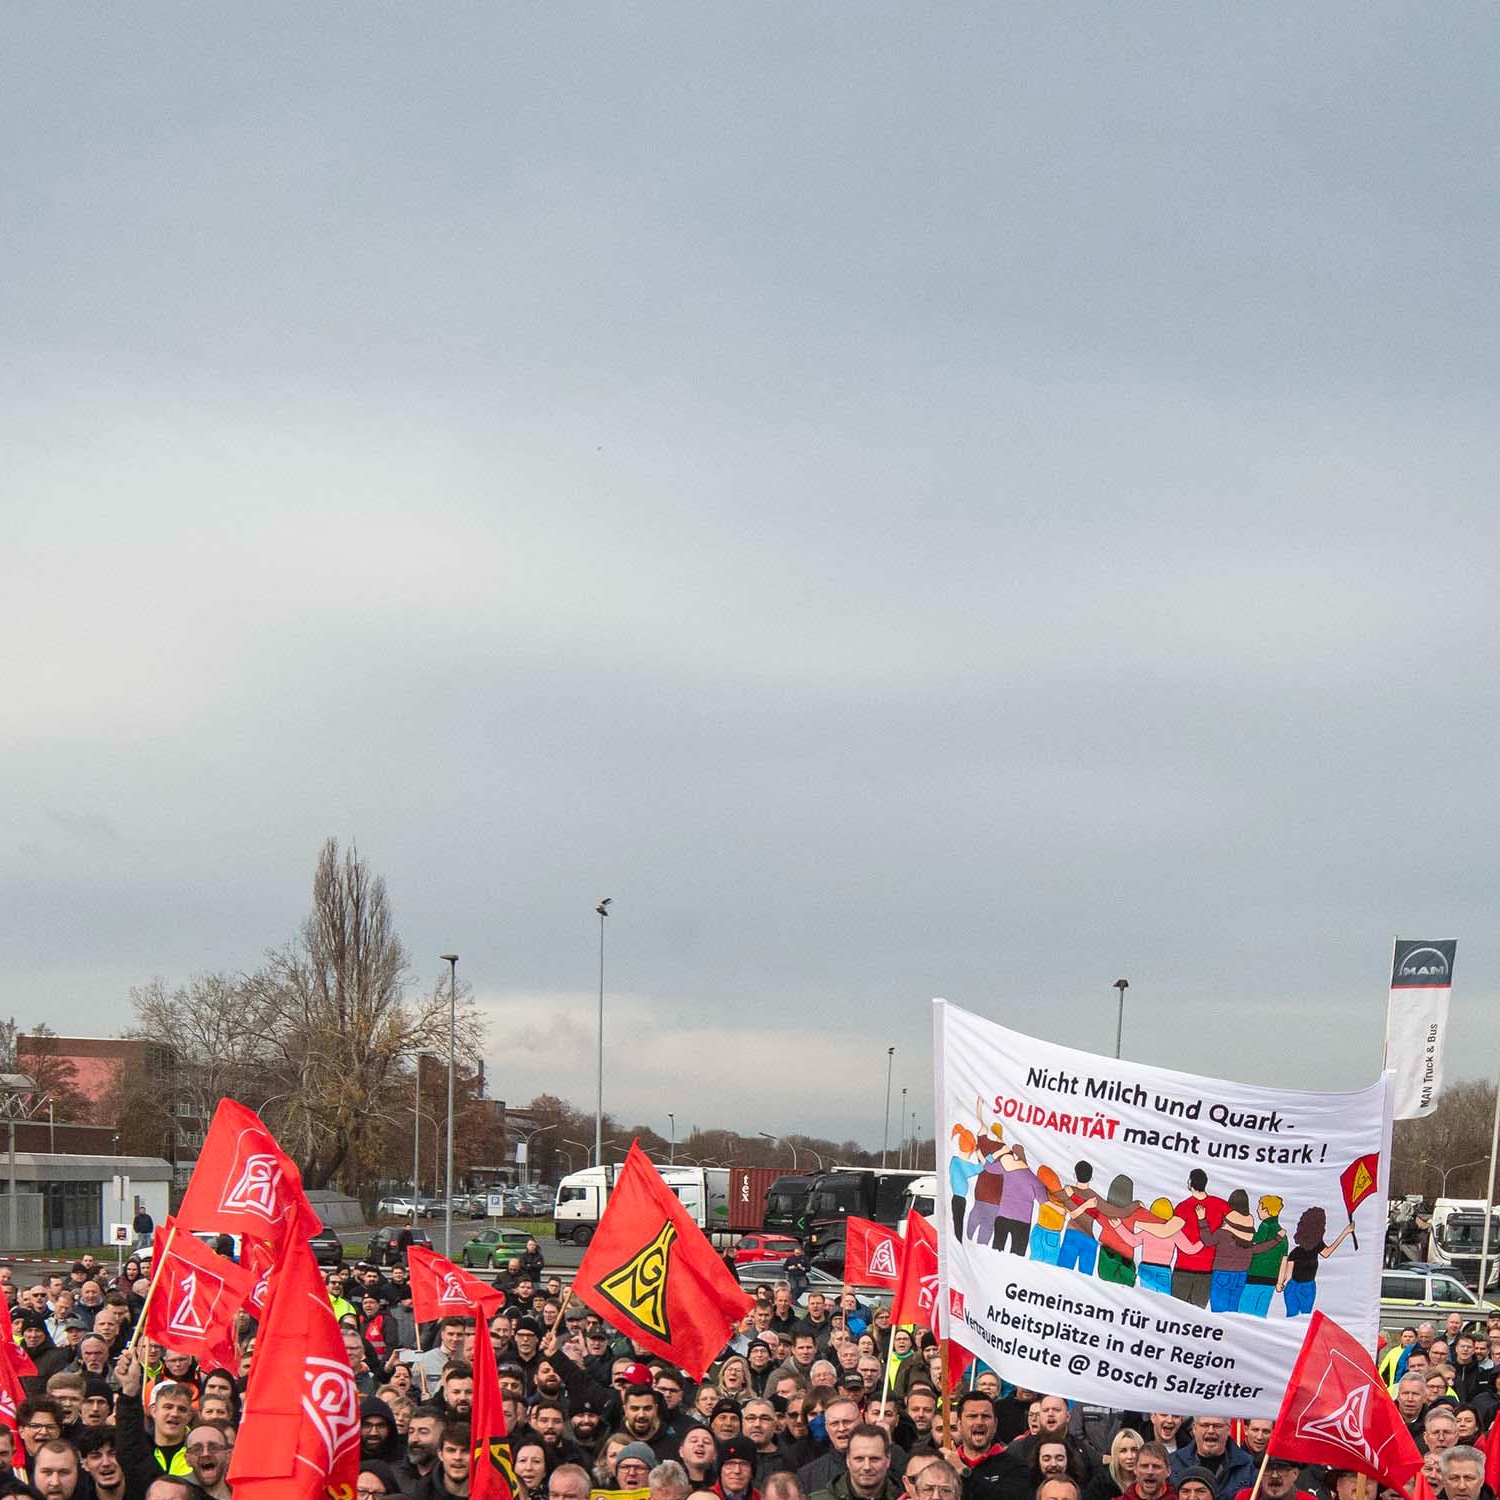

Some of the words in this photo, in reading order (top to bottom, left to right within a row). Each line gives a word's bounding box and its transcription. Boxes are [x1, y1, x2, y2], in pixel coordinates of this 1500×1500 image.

[1428, 1024, 1438, 1043] Bus
[1026, 1066, 1078, 1095] Nicht
[1084, 1077, 1148, 1107] Milch
[1154, 1095, 1202, 1121] und
[1209, 1104, 1283, 1133] Quark
[1420, 1087, 1432, 1108] MAN
[1423, 1056, 1434, 1084] Truck
[993, 1095, 1120, 1140] SOLIDARITÄT
[1123, 1125, 1200, 1155] macht
[1207, 1141, 1249, 1161] uns
[1255, 1143, 1314, 1164] stark
[987, 1304, 1100, 1347] Arbeitsplätze
[1106, 1334, 1125, 1351] in
[1131, 1339, 1165, 1361] der
[1170, 1345, 1236, 1370] Region
[1005, 1282, 1114, 1323] Gemeinsam
[1121, 1308, 1150, 1330] für
[1155, 1320, 1225, 1342] unsere
[963, 1308, 1062, 1367] Vertrauensleute
[1067, 1354, 1091, 1375] @
[1096, 1360, 1158, 1389] Bosch
[1163, 1374, 1264, 1400] Salzgitter
